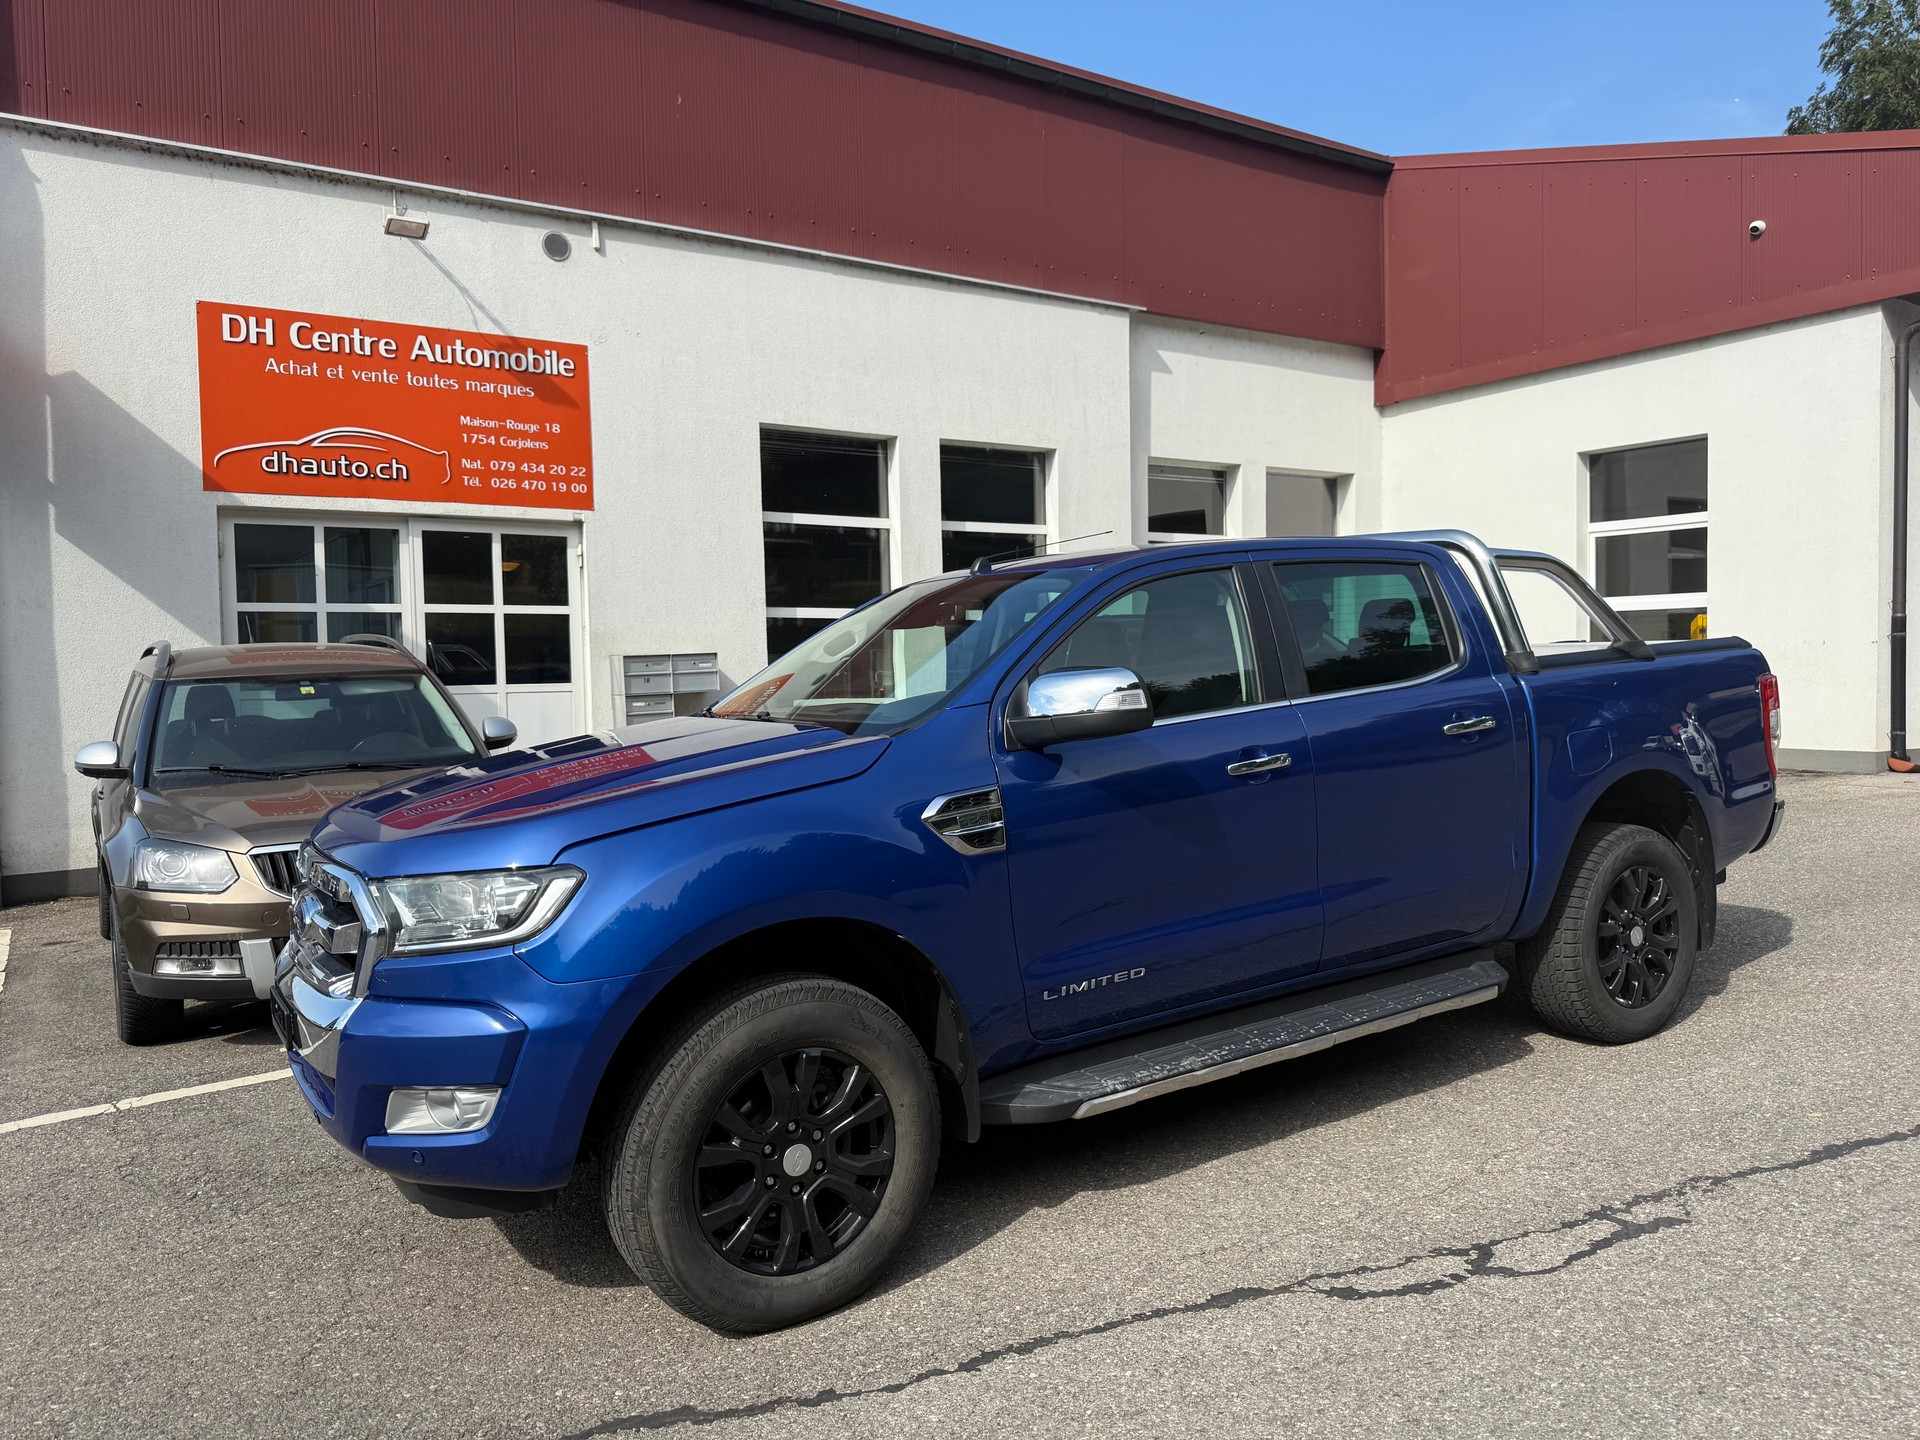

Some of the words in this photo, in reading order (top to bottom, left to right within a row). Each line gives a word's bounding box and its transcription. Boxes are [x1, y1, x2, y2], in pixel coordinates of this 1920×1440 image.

[221, 313, 275, 346] DH
[289, 321, 398, 359] Centre
[410, 334, 576, 378] Automobile
[264, 357, 319, 378] Achat
[326, 364, 345, 380] et
[351, 367, 399, 385] vente
[406, 371, 459, 390] toutes
[465, 379, 535, 398] marques
[460, 415, 541, 433] Maison-Rouge
[544, 423, 561, 434] 18
[461, 433, 496, 446] 1754
[499, 436, 549, 450] Corjolens
[260, 450, 409, 481] dhauto.ch
[461, 458, 485, 470] Nat.
[489, 460, 516, 472] 079
[520, 462, 545, 474] 434
[549, 464, 566, 476] 20
[570, 466, 587, 477] 22
[462, 475, 483, 487] Tél.
[490, 477, 517, 489] 026
[521, 480, 547, 491] 470
[551, 482, 567, 492] 19
[570, 483, 588, 494] 00
[1043, 967, 1147, 1001] LIMITED
